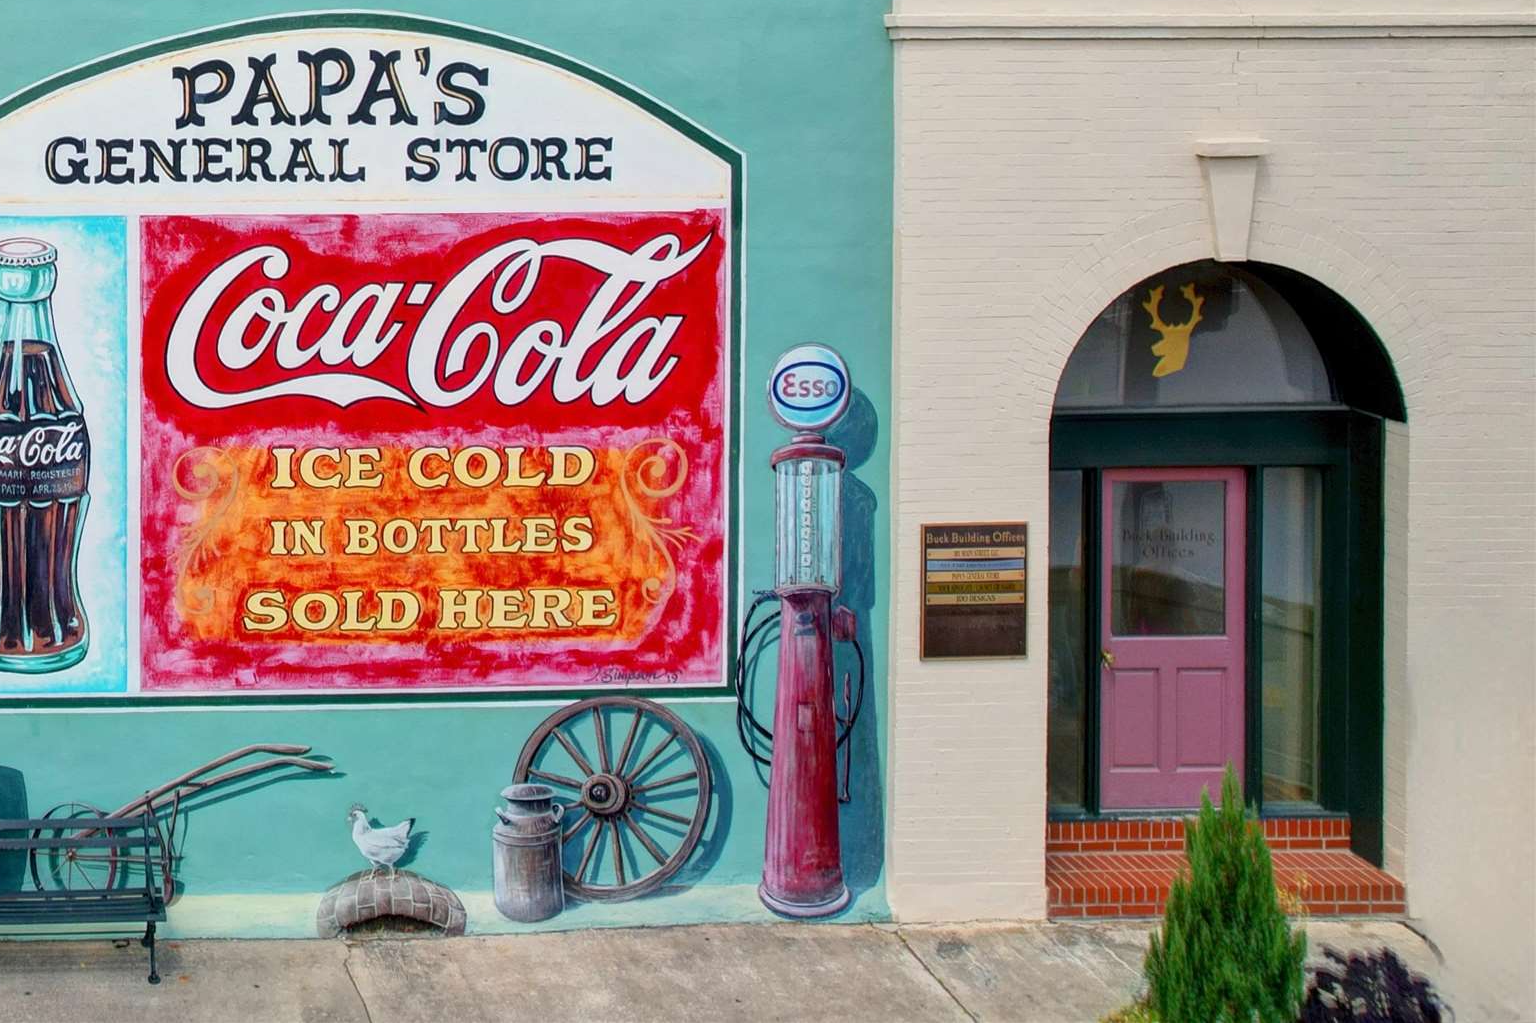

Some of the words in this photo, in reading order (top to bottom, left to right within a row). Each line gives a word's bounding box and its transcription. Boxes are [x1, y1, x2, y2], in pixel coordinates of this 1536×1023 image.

[172, 46, 490, 129] PAPA'S
[45, 136, 365, 184] GENERAL
[406, 136, 613, 182] STORE
[165, 229, 716, 413] Coca-Cola
[270, 445, 384, 489] ICE
[408, 445, 597, 489] COLD
[268, 519, 326, 556] IN
[343, 516, 595, 555] BOTTLES
[926, 532, 950, 544] Buck
[952, 532, 990, 544] Building
[1160, 529, 1214, 545] Building
[242, 588, 422, 632] SOLD
[437, 588, 619, 630] HERE
[601, 667, 663, 687] Simpson
